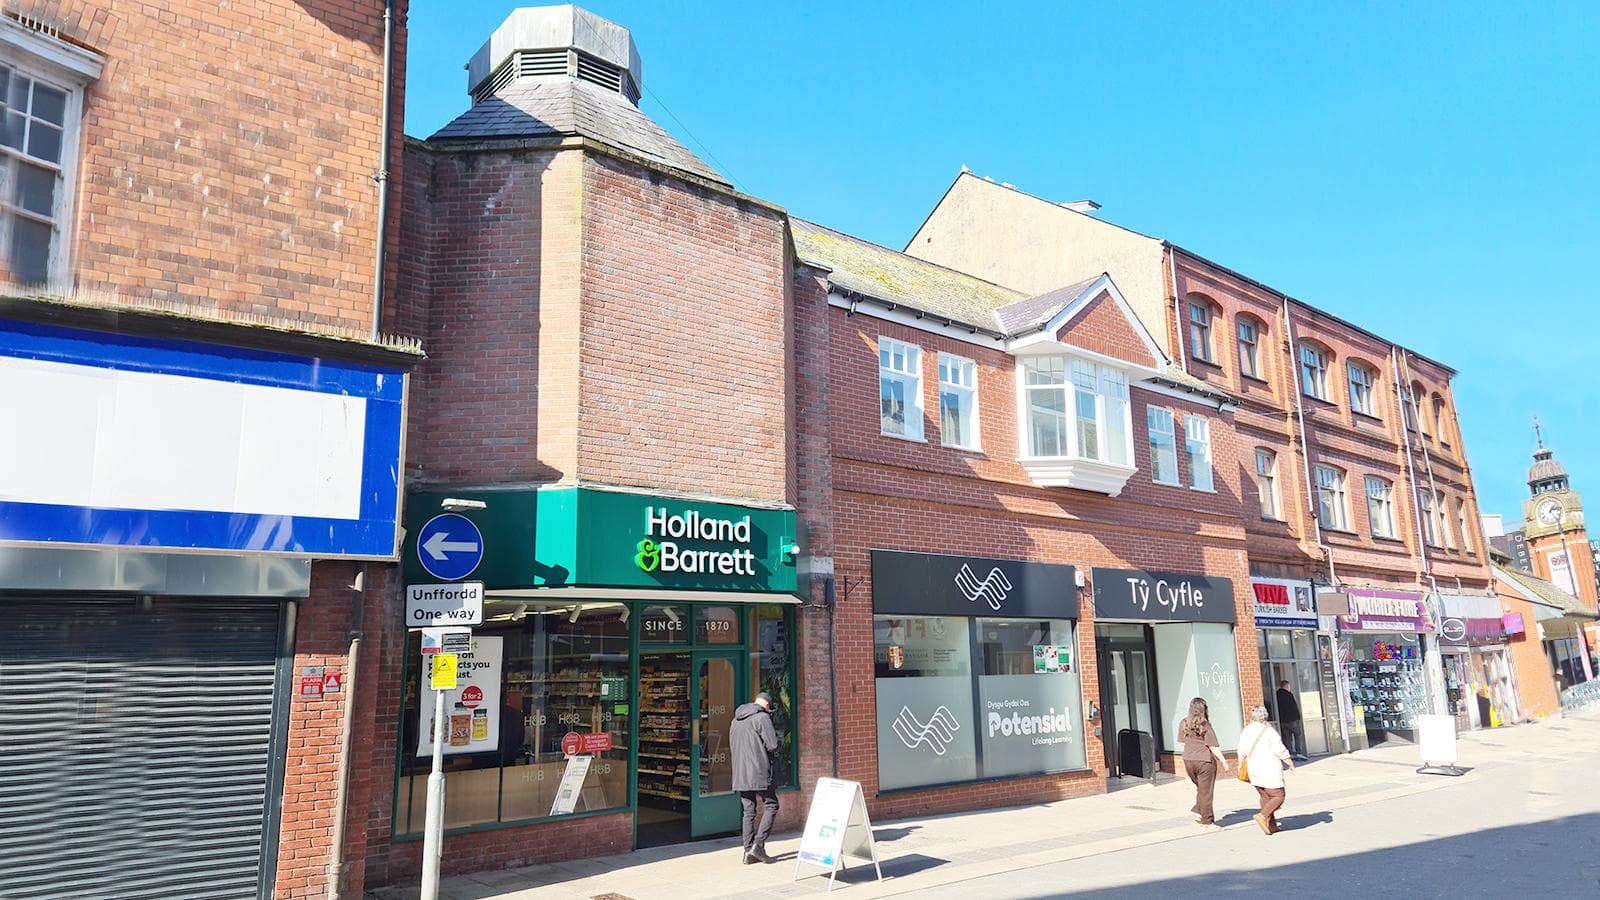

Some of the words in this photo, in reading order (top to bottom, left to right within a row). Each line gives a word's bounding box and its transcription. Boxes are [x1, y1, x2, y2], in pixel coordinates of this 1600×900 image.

[645, 506, 750, 543] Holland
[660, 541, 755, 575] Barrett
[413, 588, 476, 600] Unffordd
[1127, 577, 1149, 612] Tŷ
[1156, 580, 1203, 612] Cyfle
[1253, 583, 1290, 605] VIVA
[414, 609, 442, 620] One
[448, 610, 474, 620] way
[645, 621, 682, 631] SINCE
[705, 621, 730, 631] 1870
[472, 662, 490, 670] you
[1212, 672, 1235, 686] Cyfle
[988, 706, 1072, 738] Potensial
